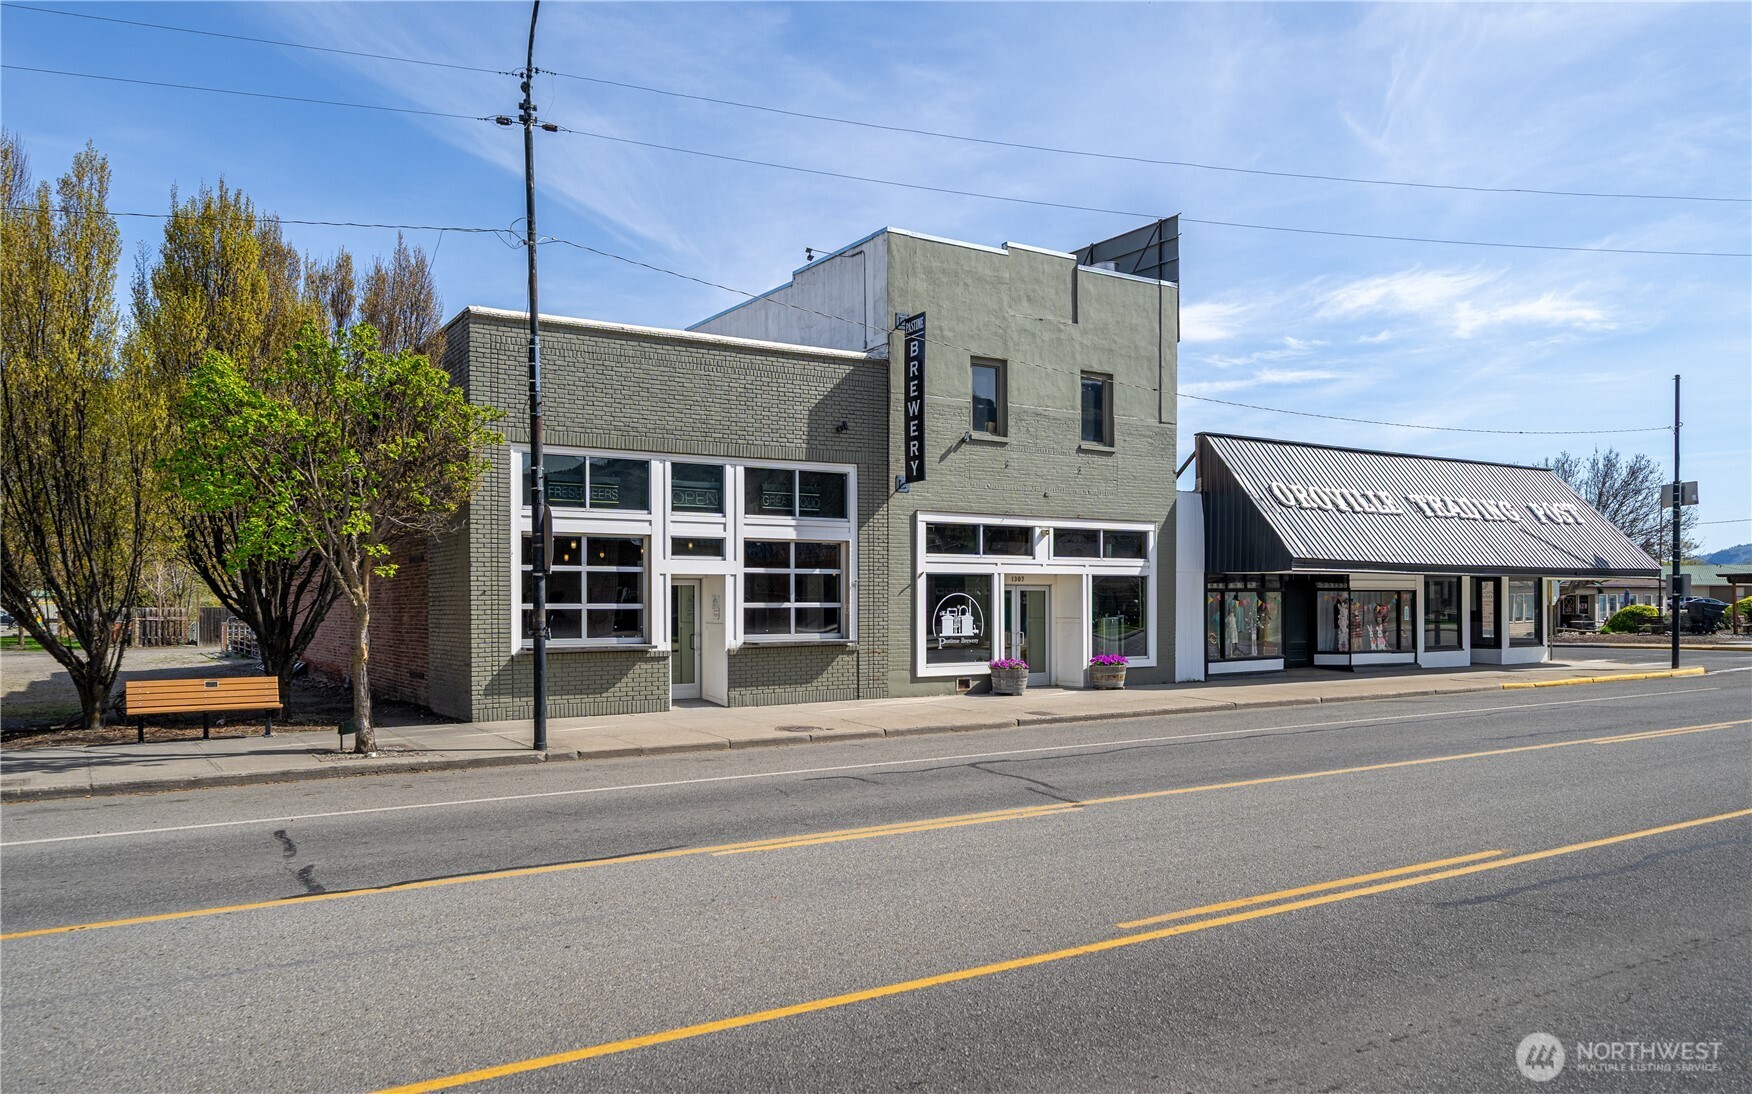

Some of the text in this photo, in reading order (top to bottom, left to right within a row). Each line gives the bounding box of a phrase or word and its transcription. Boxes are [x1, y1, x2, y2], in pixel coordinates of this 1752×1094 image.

[907, 341, 920, 476] BREWERY
[547, 486, 619, 500] FRESH EERS
[672, 490, 719, 505] OPEN
[799, 497, 820, 509] OOD
[1270, 481, 1585, 526] OROVILLE TRADING POST
[1011, 575, 1025, 583] 1307
